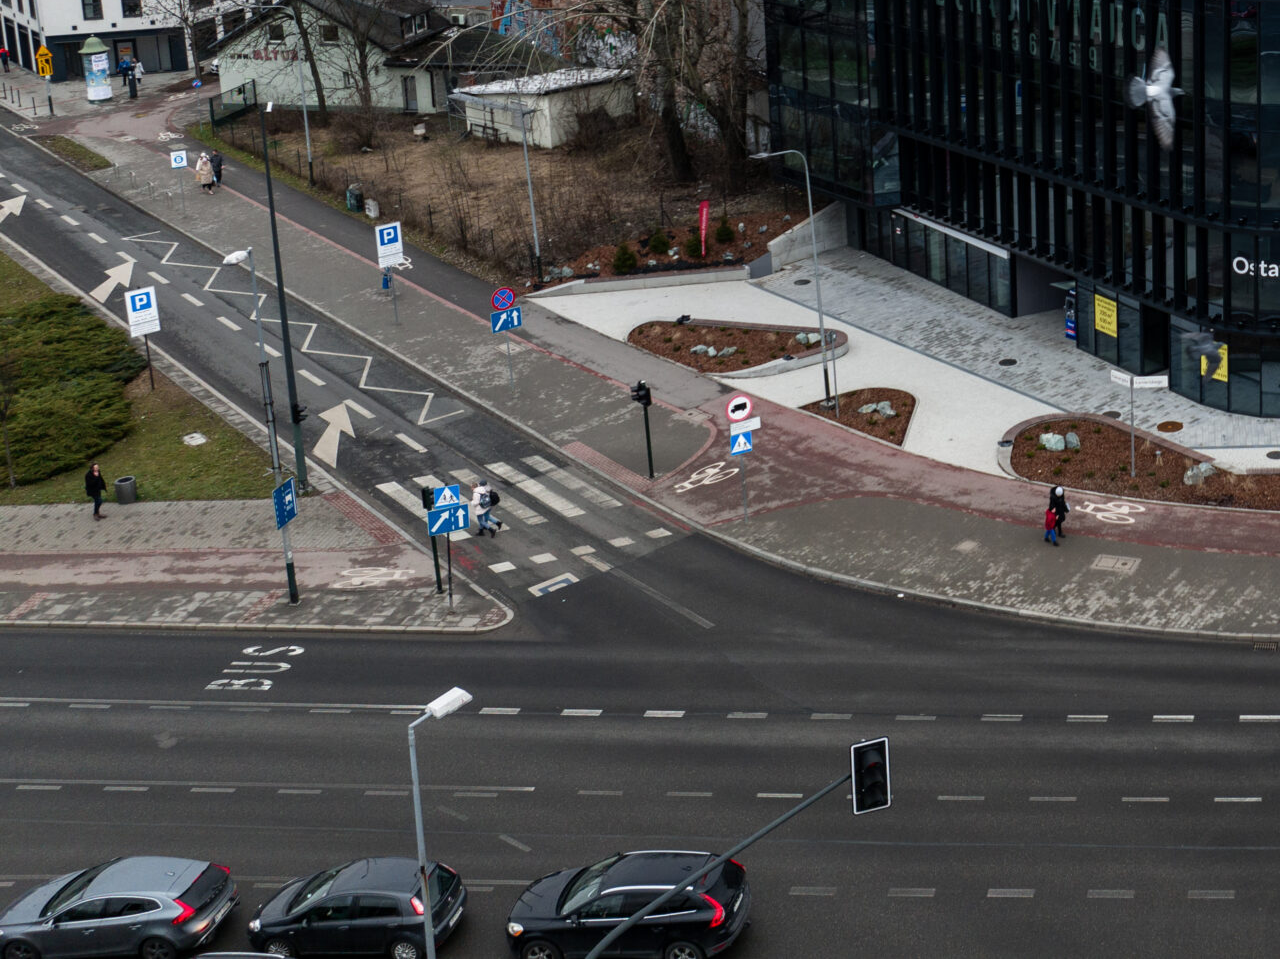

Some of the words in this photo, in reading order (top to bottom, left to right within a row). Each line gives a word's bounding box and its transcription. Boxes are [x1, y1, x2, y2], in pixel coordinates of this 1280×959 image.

[383, 228, 395, 244] P
[134, 294, 148, 310] P
[203, 645, 305, 691] BUS
